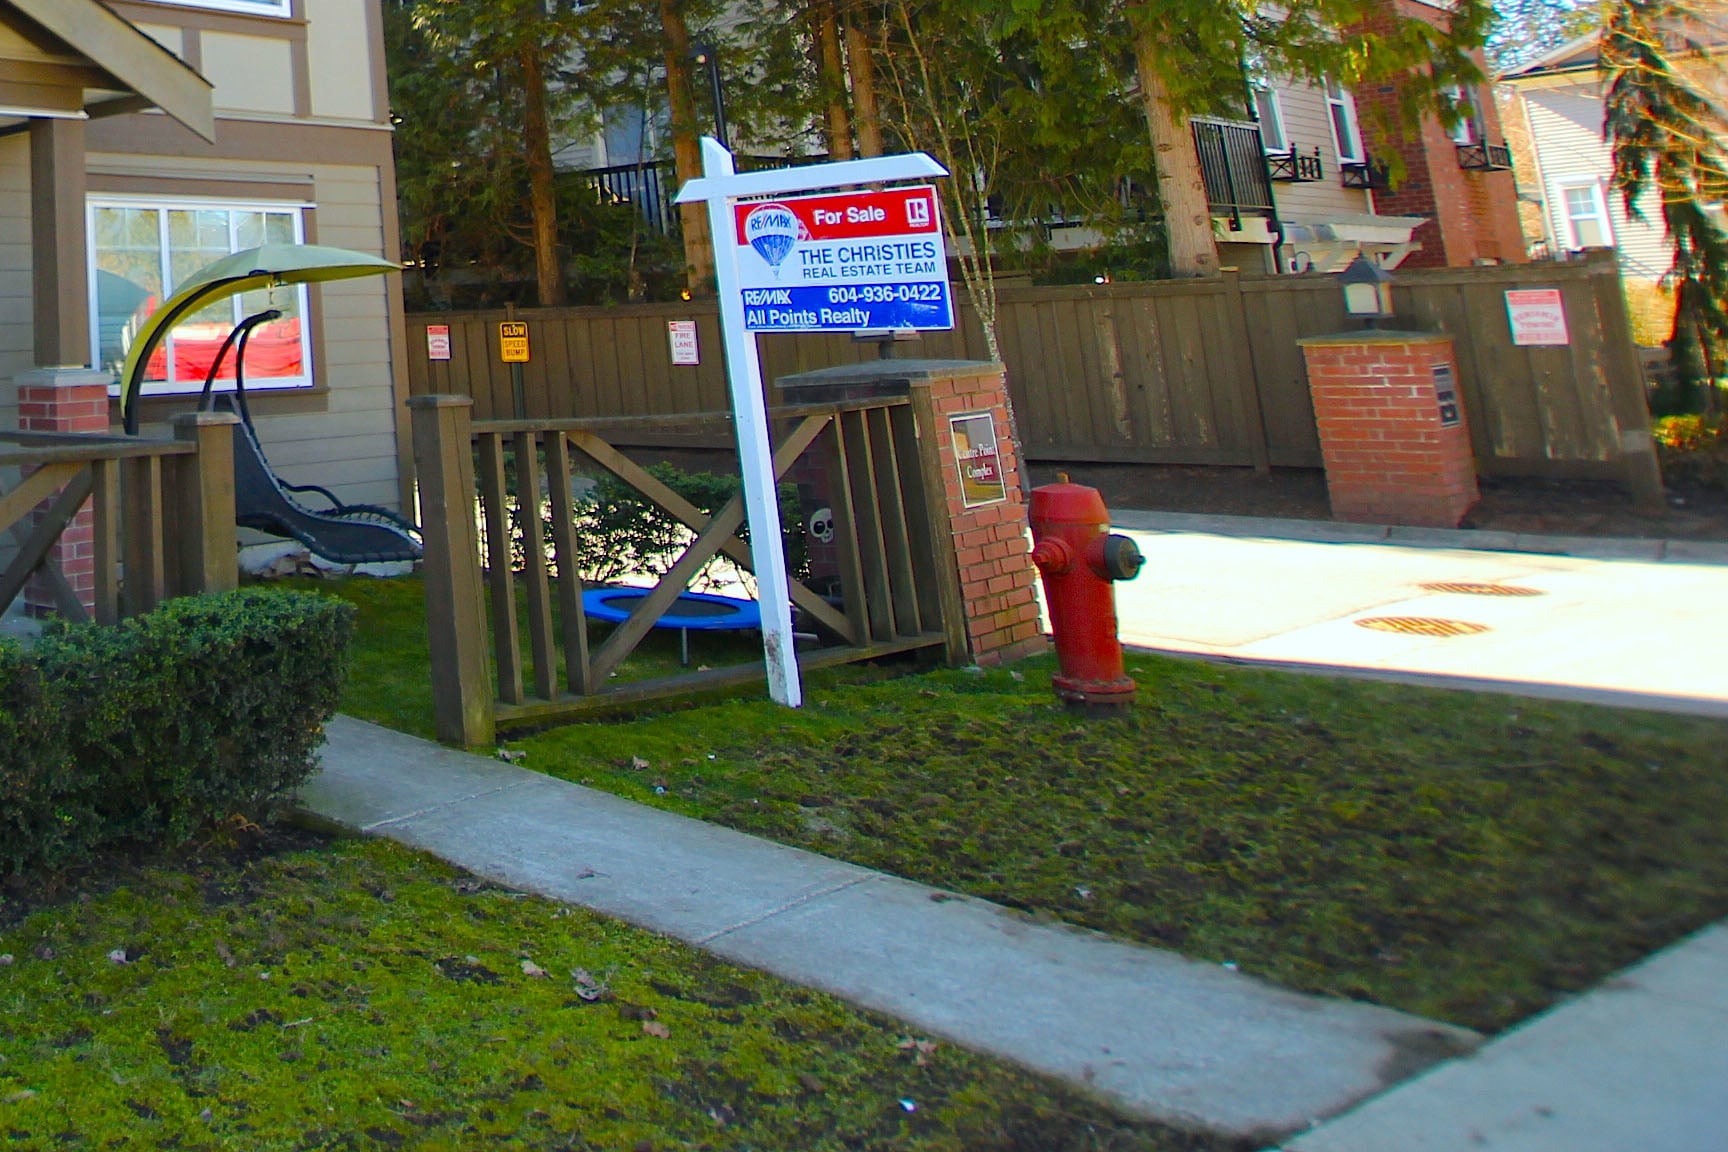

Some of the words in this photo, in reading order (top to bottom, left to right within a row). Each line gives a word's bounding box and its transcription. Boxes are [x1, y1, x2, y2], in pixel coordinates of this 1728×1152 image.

[751, 214, 791, 231] RE/MAX
[813, 209, 842, 225] For
[847, 205, 885, 223] Sale
[799, 249, 833, 265] THE
[803, 268, 837, 279] REAL
[842, 264, 892, 277] ESTATE
[896, 262, 936, 274] TEAM
[745, 289, 792, 305] RE/MAX
[829, 284, 941, 304] 604-936-0422
[747, 310, 765, 325] All
[770, 309, 817, 325] Points
[822, 308, 870, 327] Realty
[503, 326, 525, 336] SLOW
[967, 463, 993, 480] Complex
